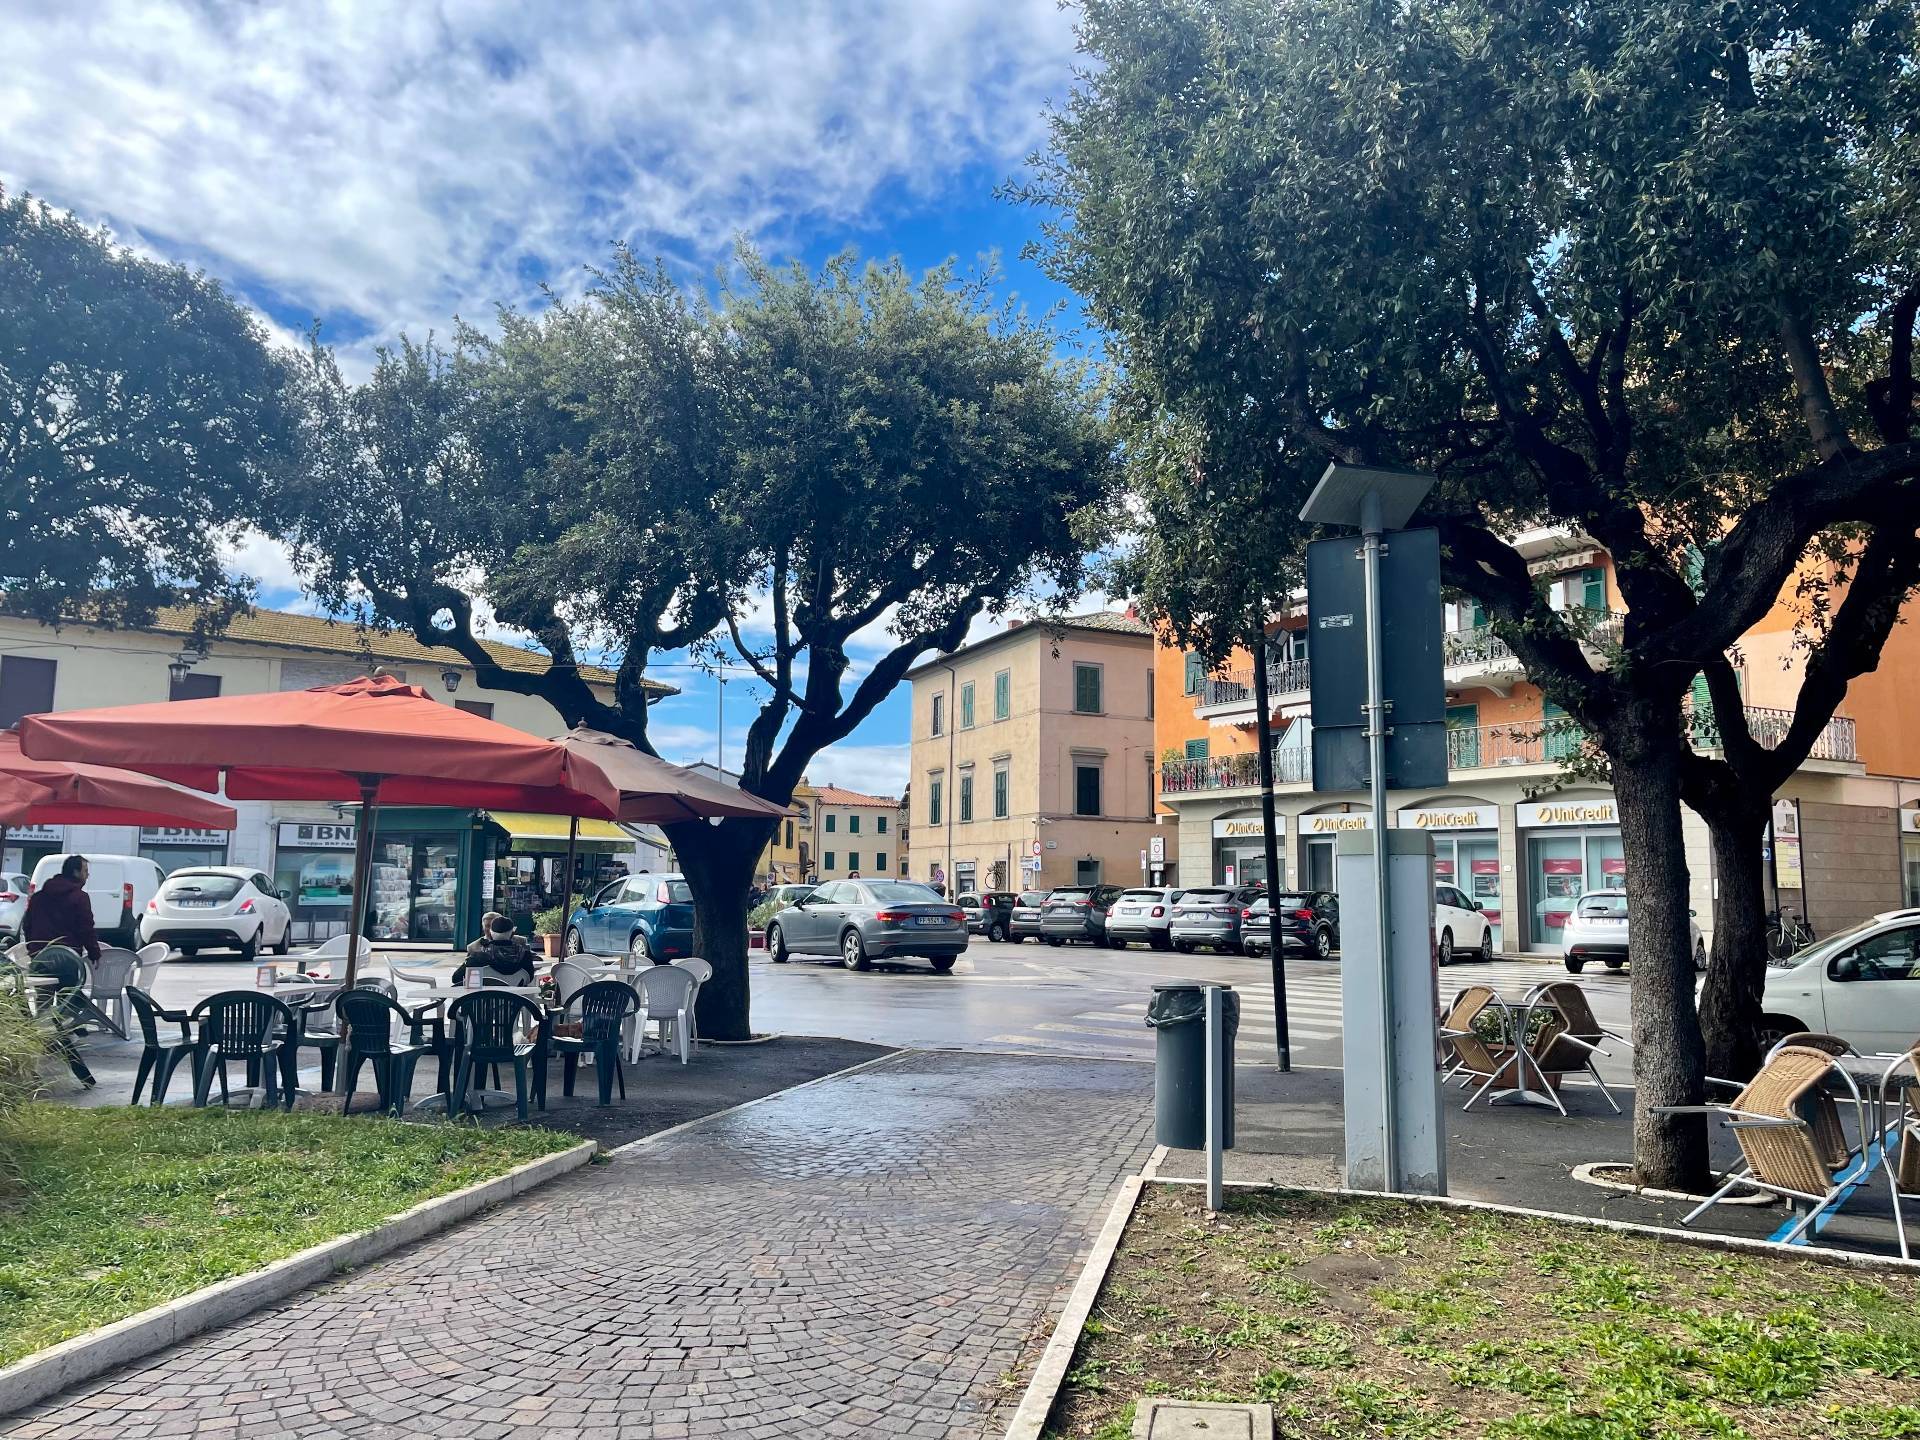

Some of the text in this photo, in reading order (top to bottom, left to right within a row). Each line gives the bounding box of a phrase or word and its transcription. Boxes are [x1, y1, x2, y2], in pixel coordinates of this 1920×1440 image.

[1428, 811, 1478, 826] UniCredit
[1552, 805, 1612, 821] UniCredit
[1234, 821, 1265, 834] UniCred
[1324, 817, 1366, 830] UniCredit
[317, 826, 357, 840] BN
